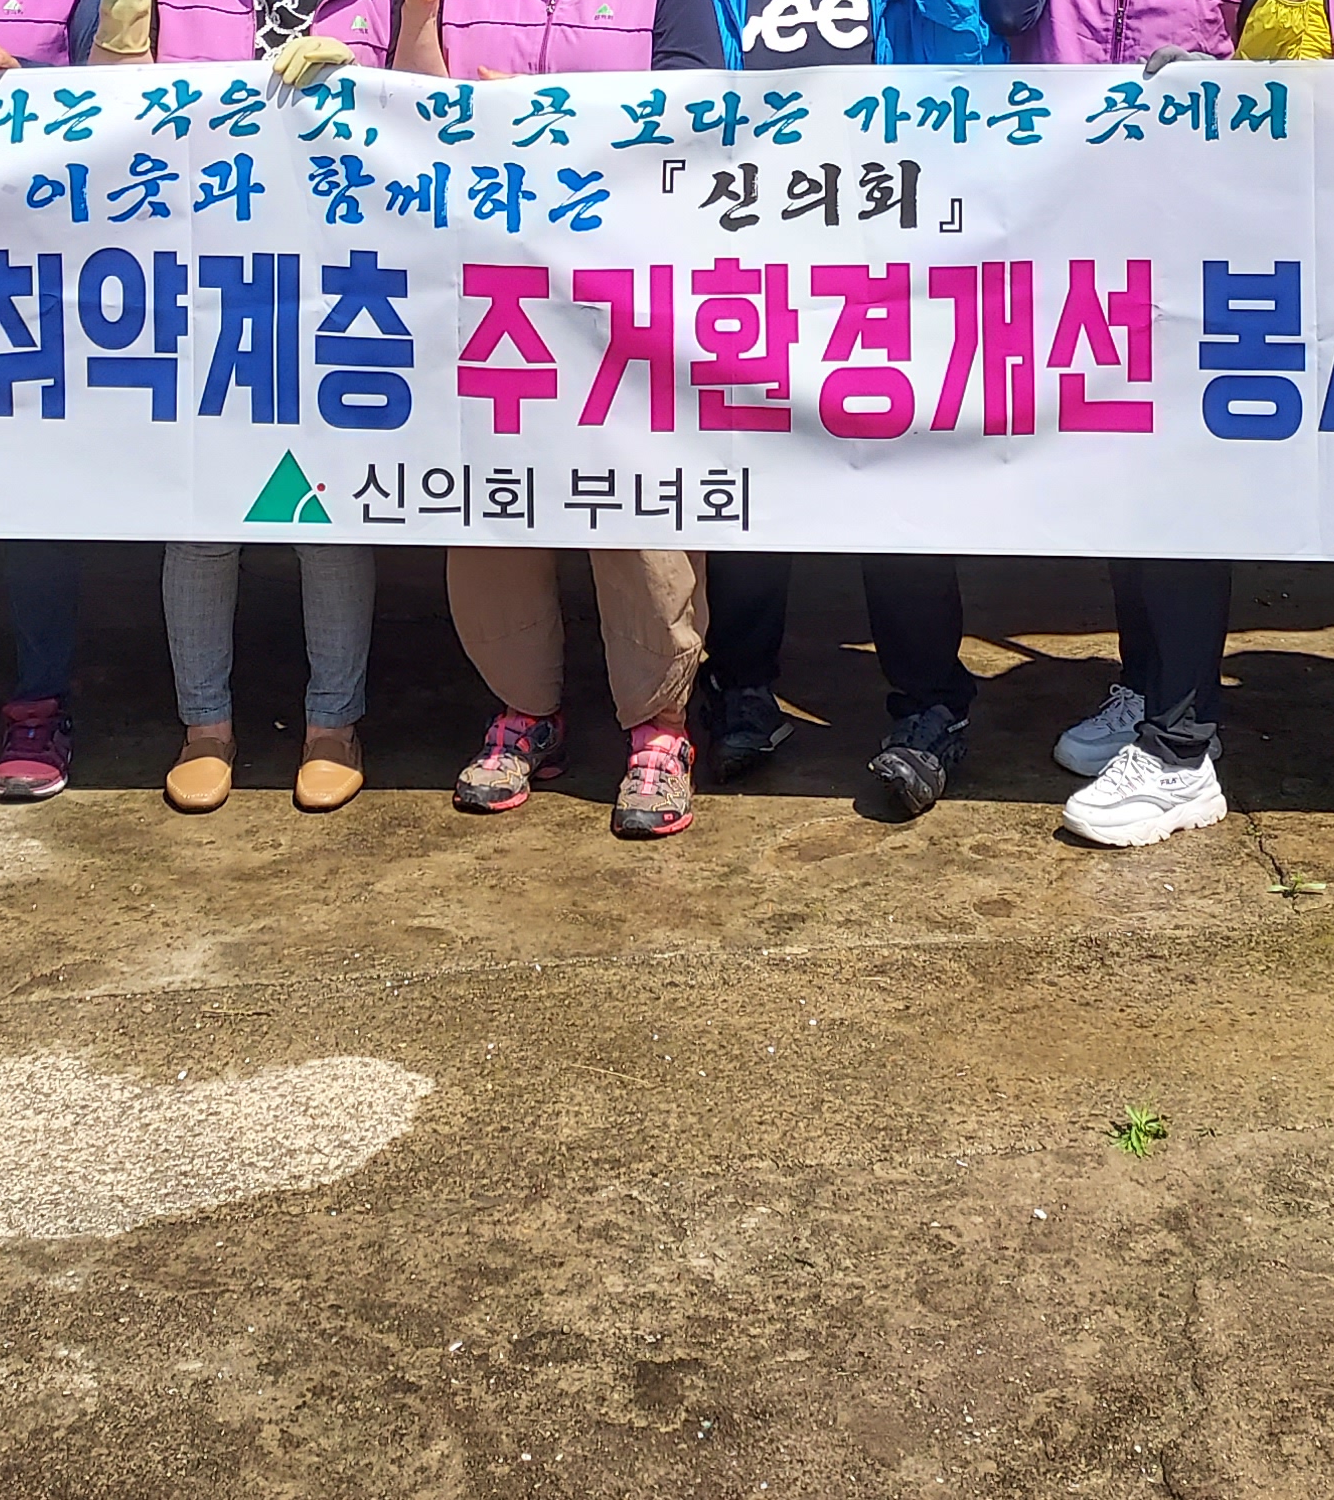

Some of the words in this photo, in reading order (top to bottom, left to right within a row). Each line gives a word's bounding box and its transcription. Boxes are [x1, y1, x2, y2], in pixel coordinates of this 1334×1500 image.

[135, 78, 267, 139] 작은
[298, 77, 379, 146] 것,
[417, 83, 476, 145] 먼
[511, 85, 578, 148] 곳
[610, 87, 810, 149] 보다는
[843, 80, 1052, 146] 가까운
[1085, 80, 1290, 144] 곳에서
[24, 152, 267, 225] 이웃과
[307, 153, 610, 233] 함께하는
[457, 257, 1155, 438] 주거환경개선
[351, 461, 536, 529] 신의회
[563, 467, 751, 531] 부녀회
